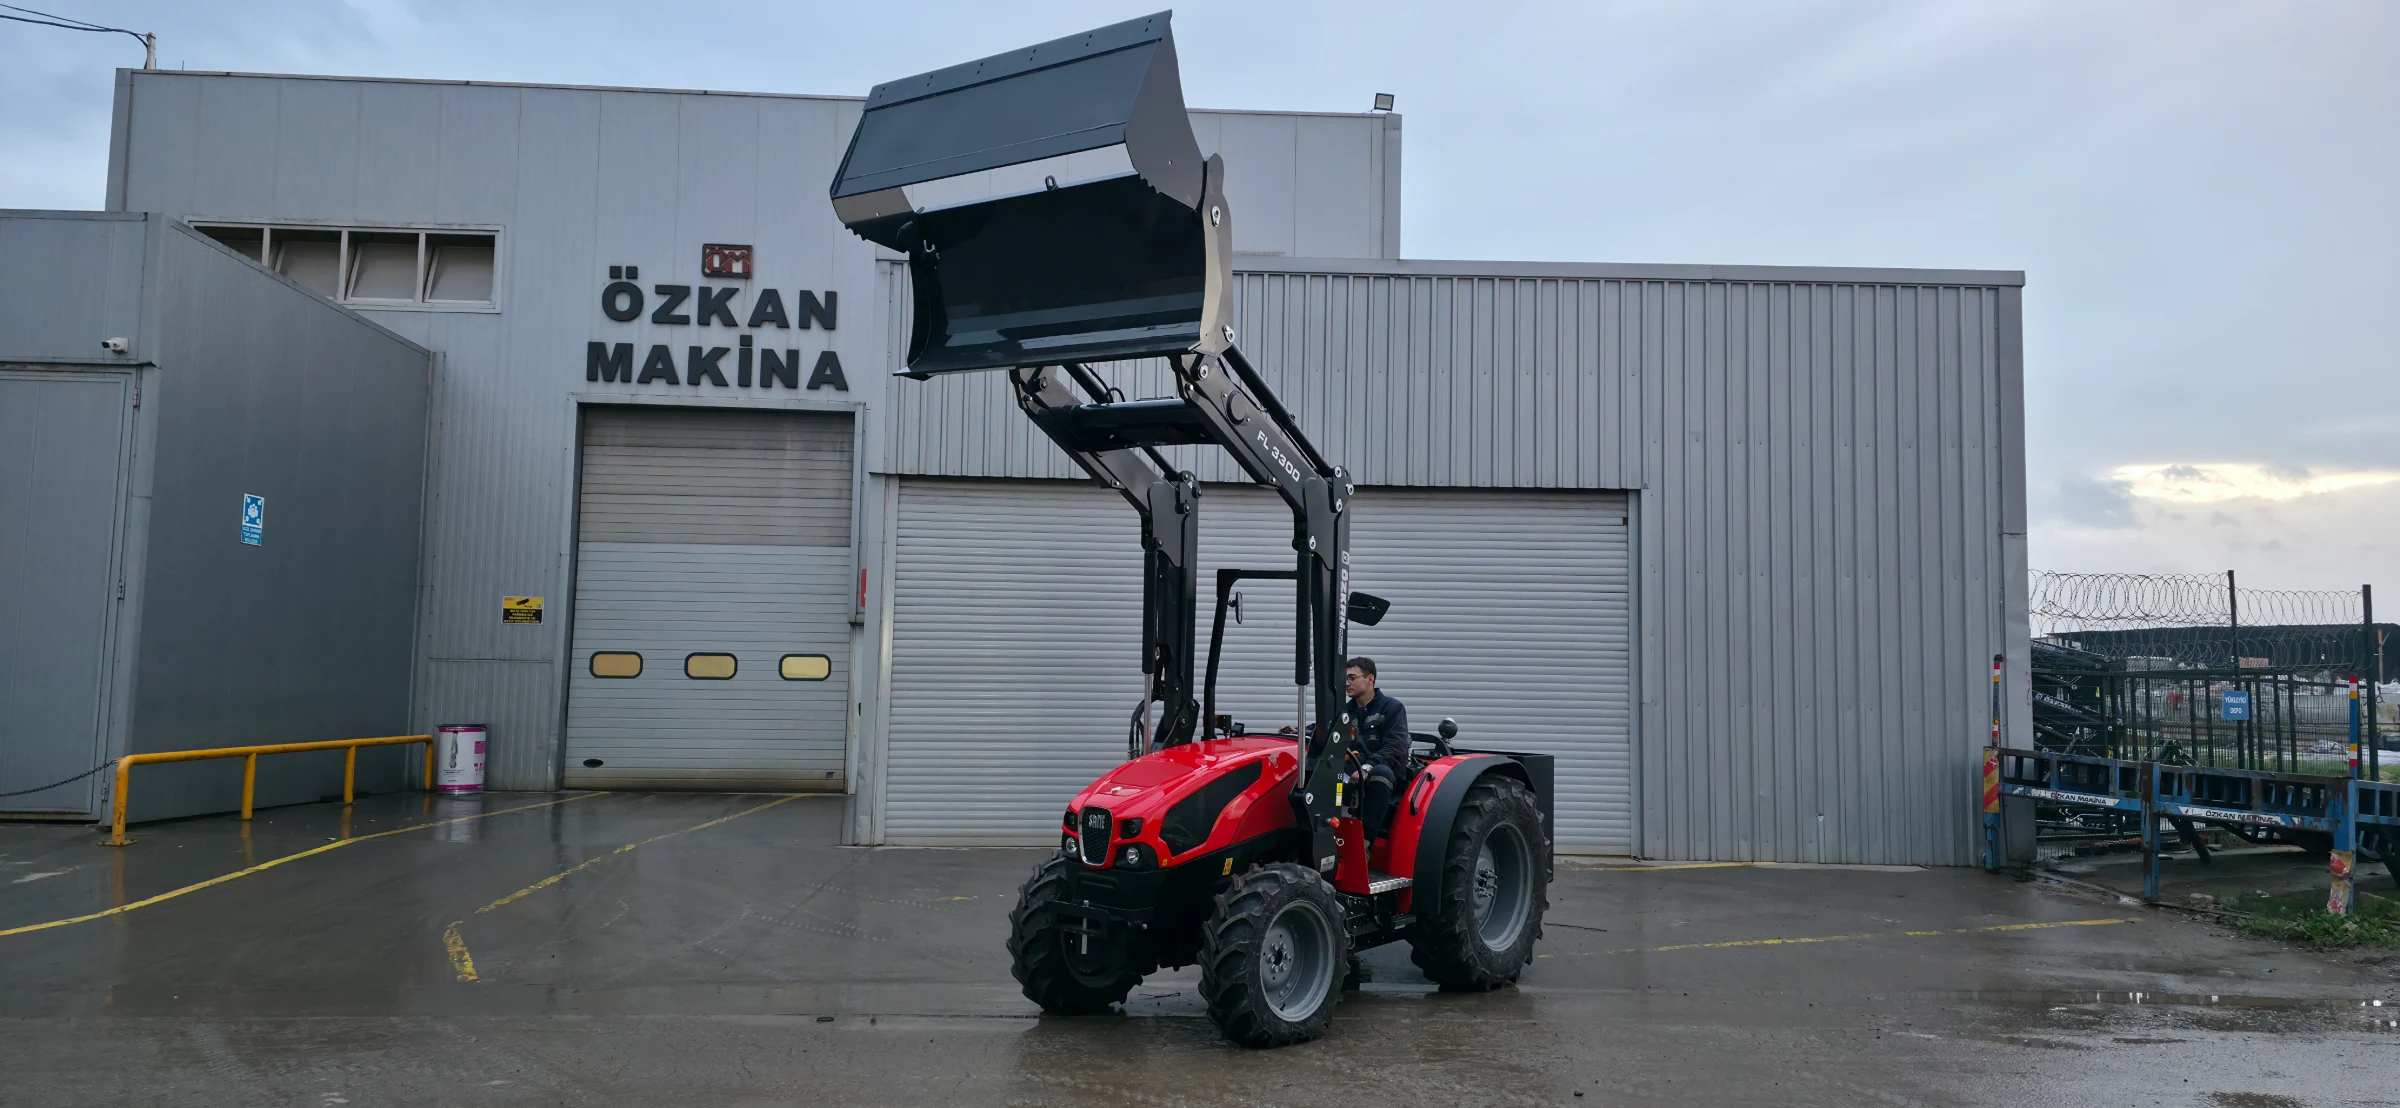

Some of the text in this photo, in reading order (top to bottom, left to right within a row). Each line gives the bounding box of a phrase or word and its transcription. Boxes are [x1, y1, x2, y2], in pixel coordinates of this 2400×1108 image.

[601, 265, 838, 331] ÖZKAN
[586, 334, 849, 392] MAKİNA
[1257, 430, 1300, 482] FL 3300
[2205, 809, 2236, 820] ÖZKAN
